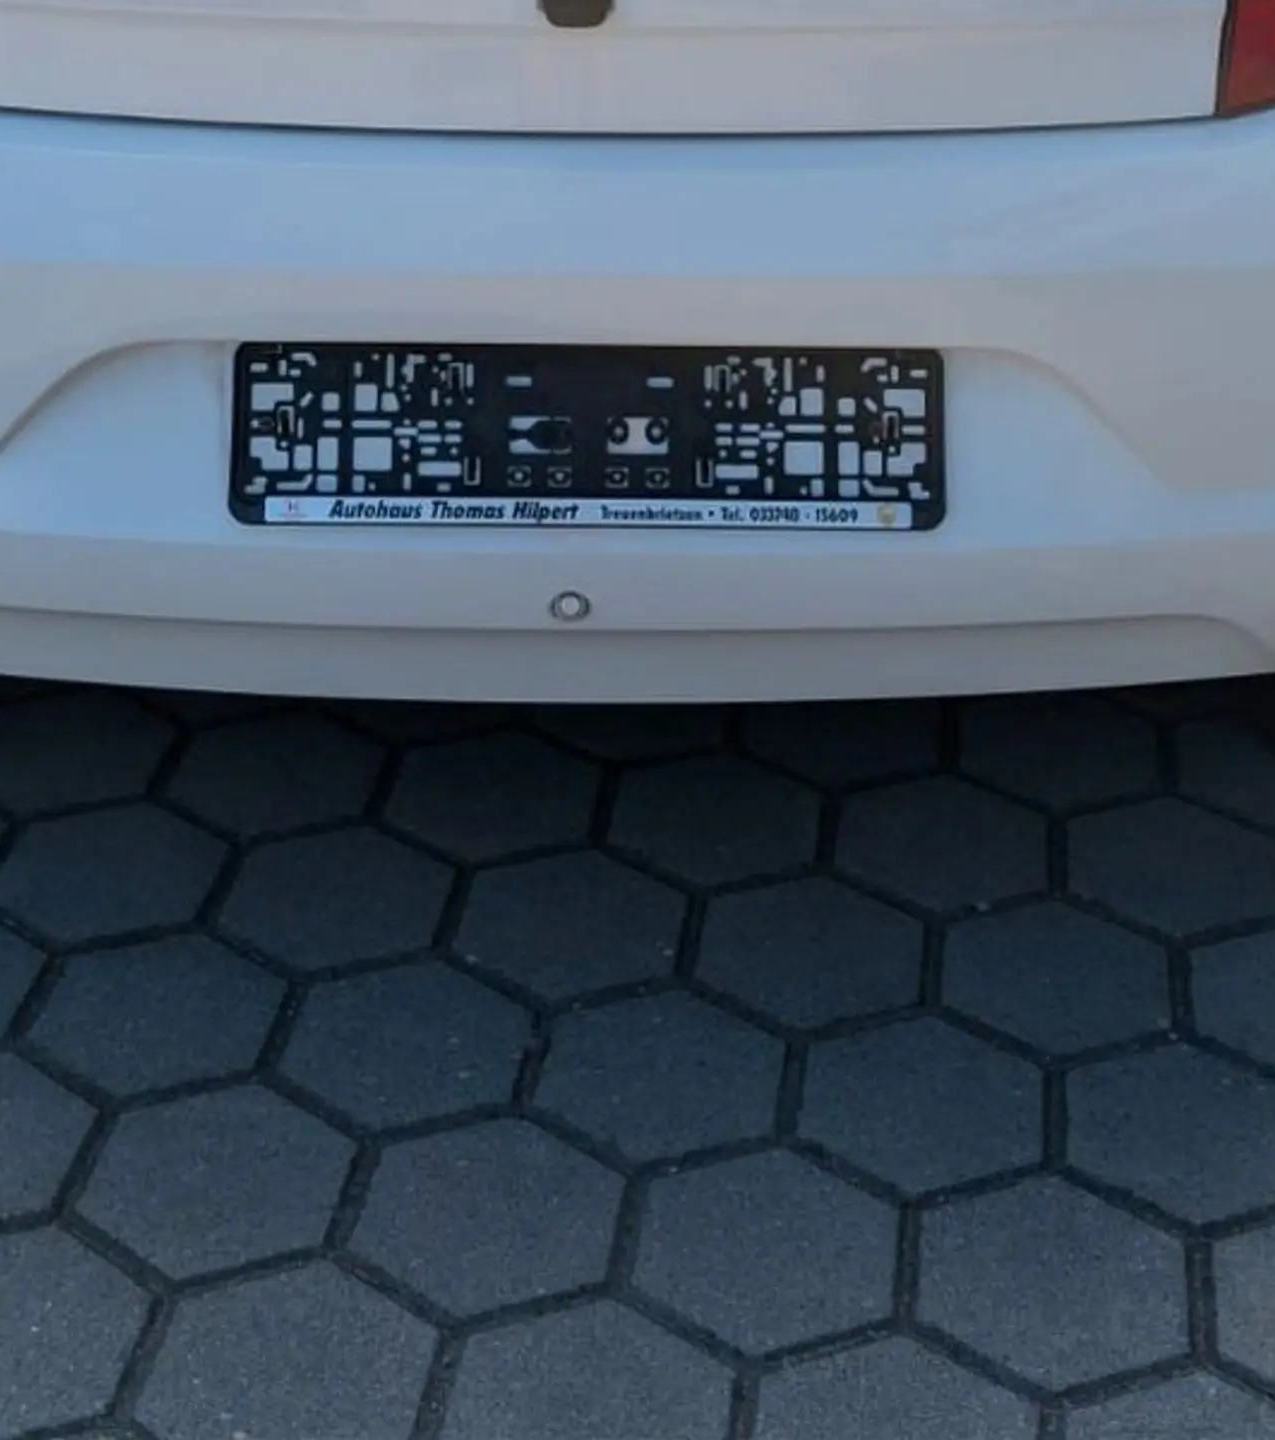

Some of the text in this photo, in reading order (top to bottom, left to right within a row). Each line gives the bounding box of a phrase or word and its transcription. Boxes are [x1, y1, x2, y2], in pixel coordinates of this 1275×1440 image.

[328, 498, 423, 520] Autohaus
[430, 499, 505, 520] Thomas
[511, 500, 580, 524] Hilpert
[720, 505, 744, 522] Tel.
